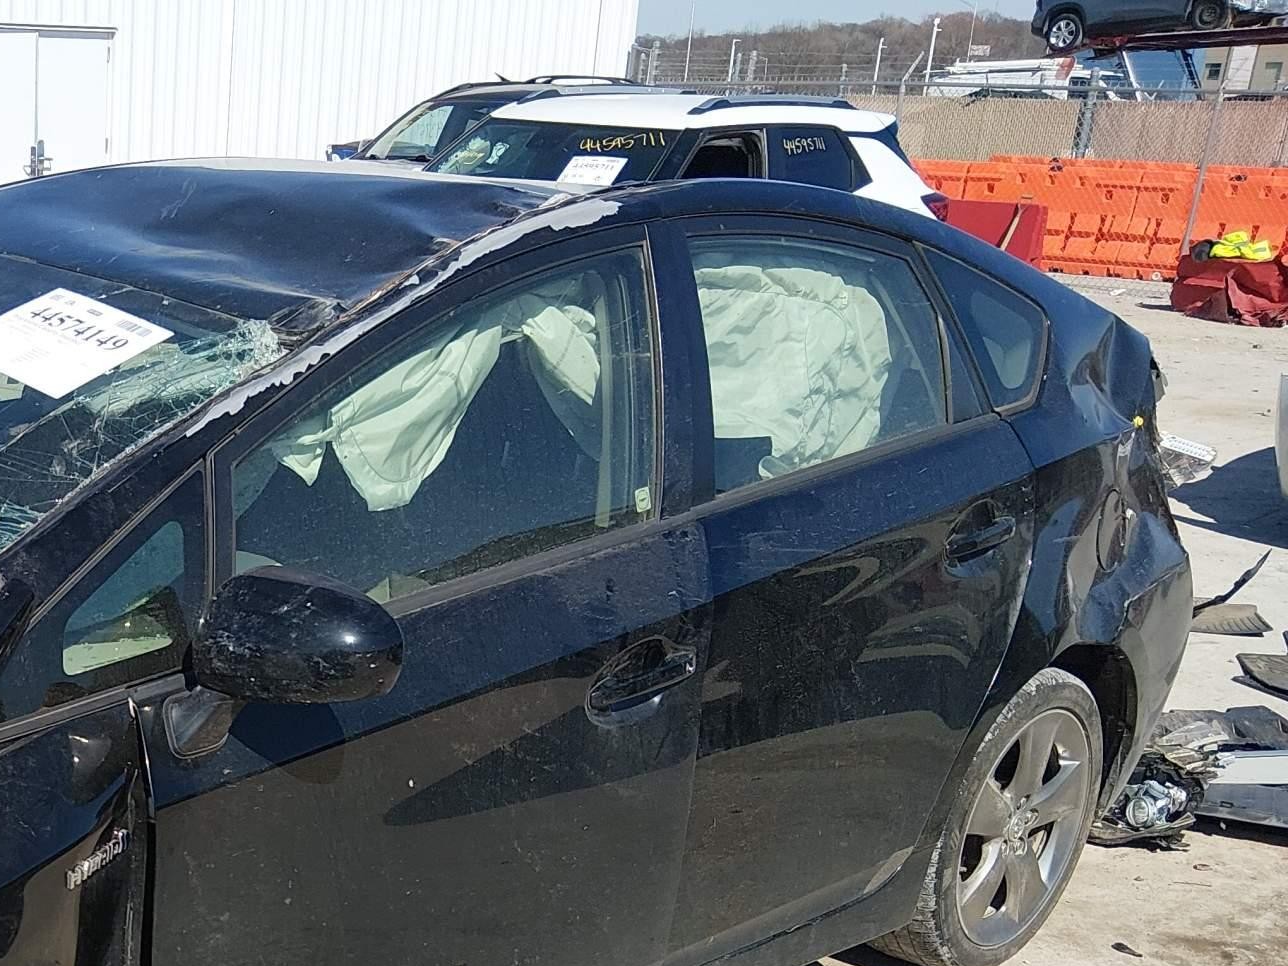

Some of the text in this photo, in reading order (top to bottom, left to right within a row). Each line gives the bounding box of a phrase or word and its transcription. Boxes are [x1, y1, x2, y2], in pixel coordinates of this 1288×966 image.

[579, 131, 665, 153] 44595711
[783, 136, 826, 156] 44595711
[30, 306, 129, 350] 44574149
